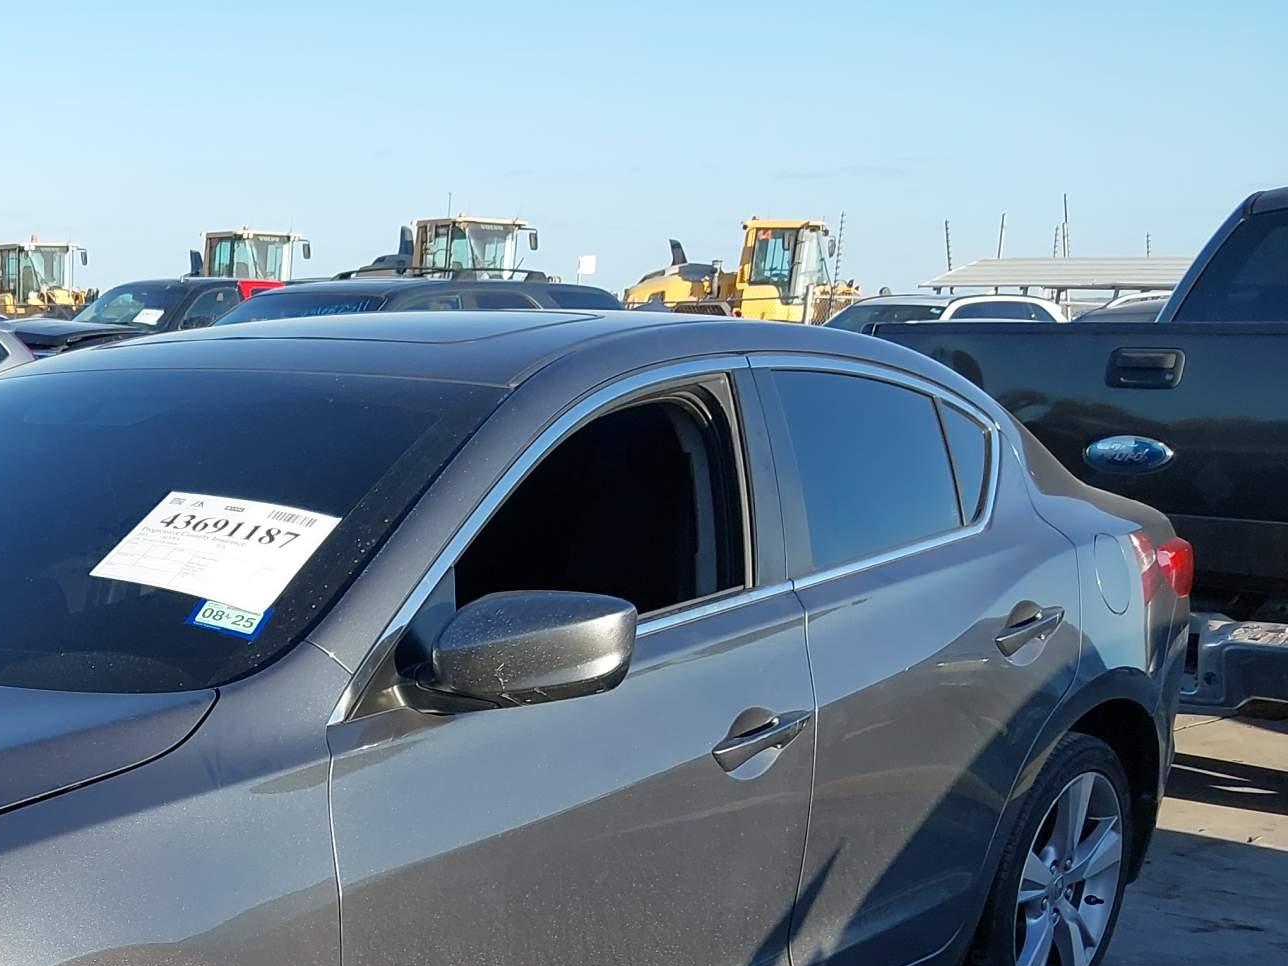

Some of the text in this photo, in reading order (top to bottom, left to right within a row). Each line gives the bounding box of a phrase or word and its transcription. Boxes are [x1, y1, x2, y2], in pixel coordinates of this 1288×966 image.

[160, 512, 302, 549] 43691187
[201, 607, 226, 621] 08
[231, 614, 257, 629] 25
